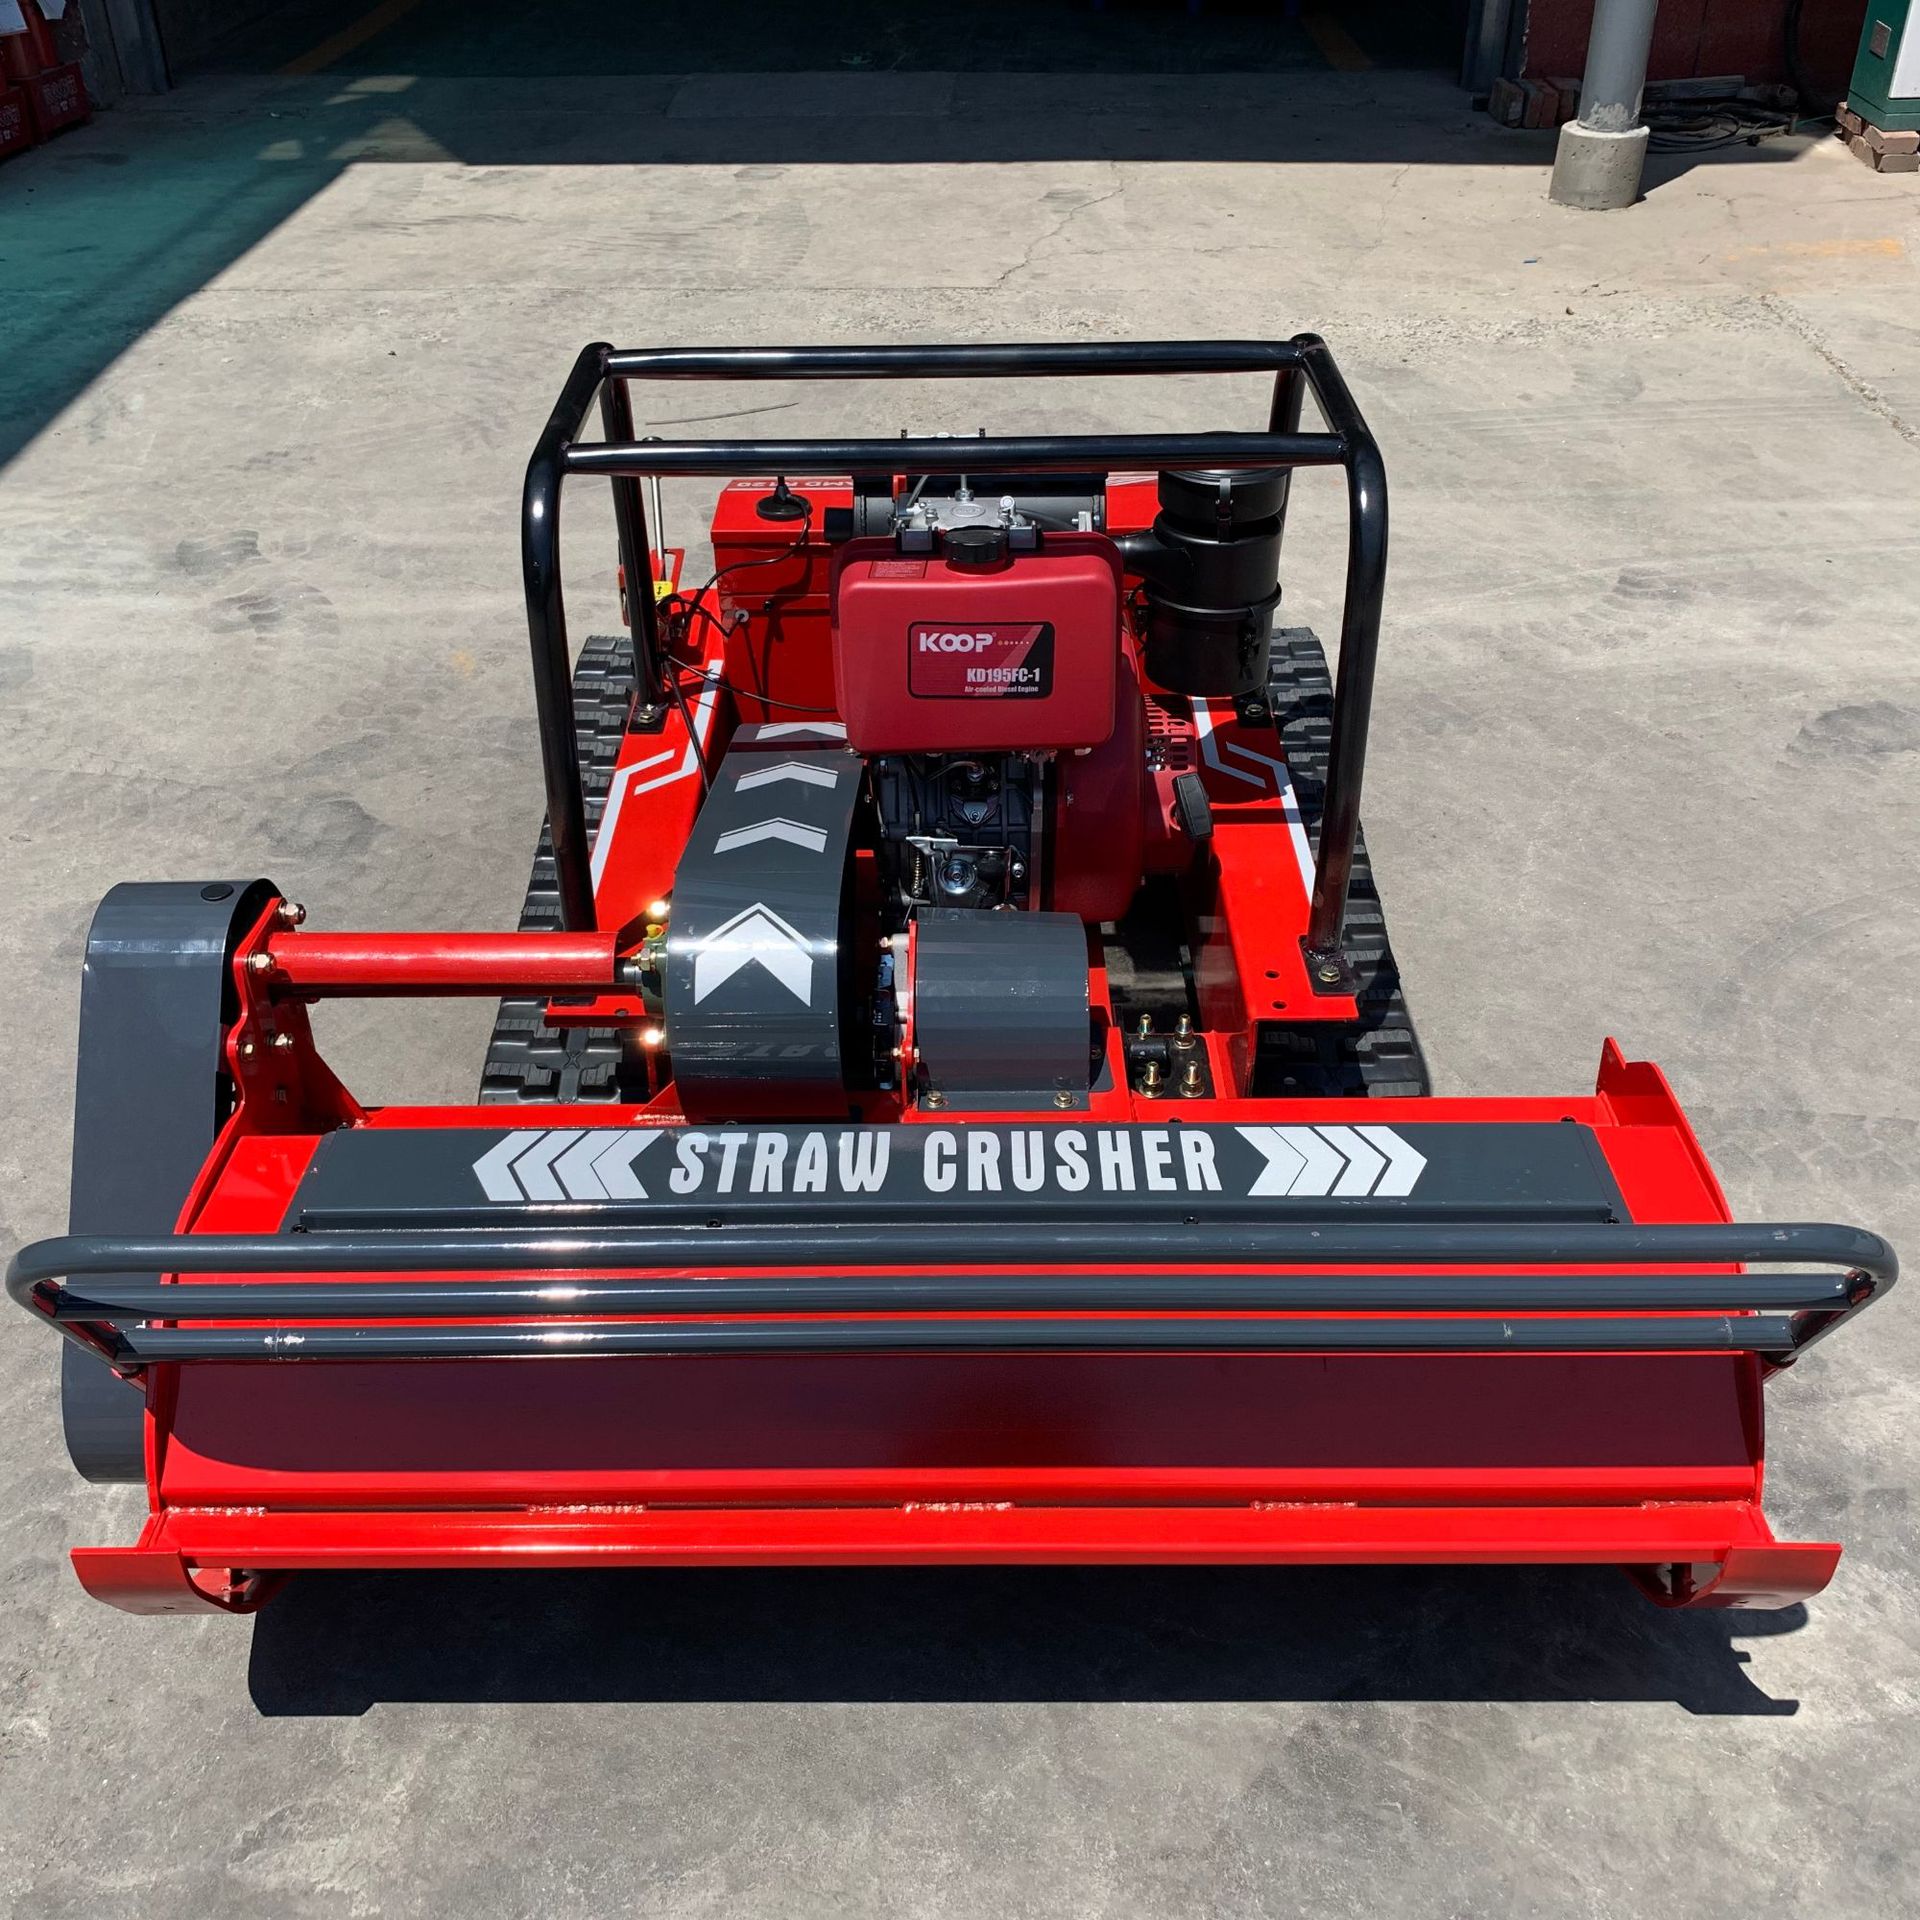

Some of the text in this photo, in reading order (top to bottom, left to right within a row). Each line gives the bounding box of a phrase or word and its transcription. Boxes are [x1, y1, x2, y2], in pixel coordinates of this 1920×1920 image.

[919, 632, 993, 652] KOOP
[967, 668, 1041, 683] KD195FC-1
[964, 685, 1039, 694] Air-cooled Diesel Engine
[669, 1129, 1223, 1194] STRAW CRUSHER
